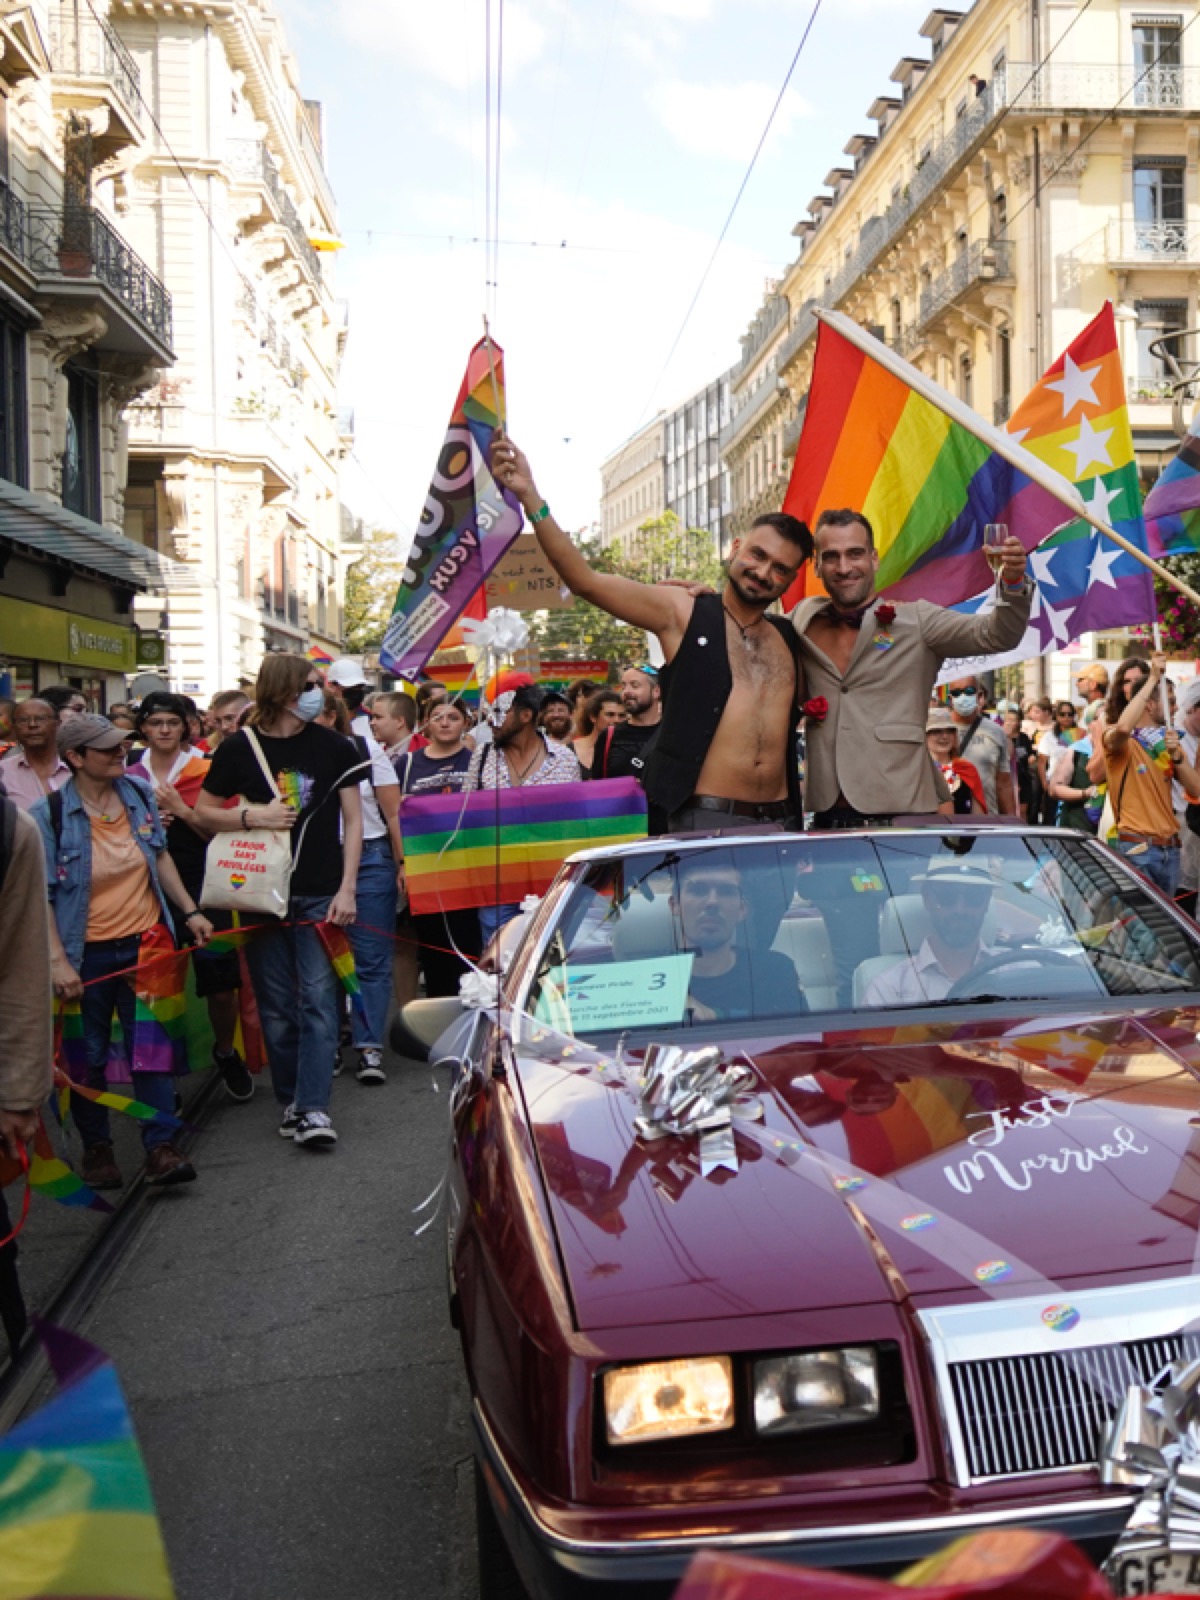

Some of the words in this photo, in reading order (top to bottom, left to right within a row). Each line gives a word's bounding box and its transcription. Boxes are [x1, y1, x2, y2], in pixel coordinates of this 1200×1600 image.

[647, 971, 667, 991] 3
[965, 1095, 1079, 1147] Just
[943, 1125, 1149, 1194] Married
